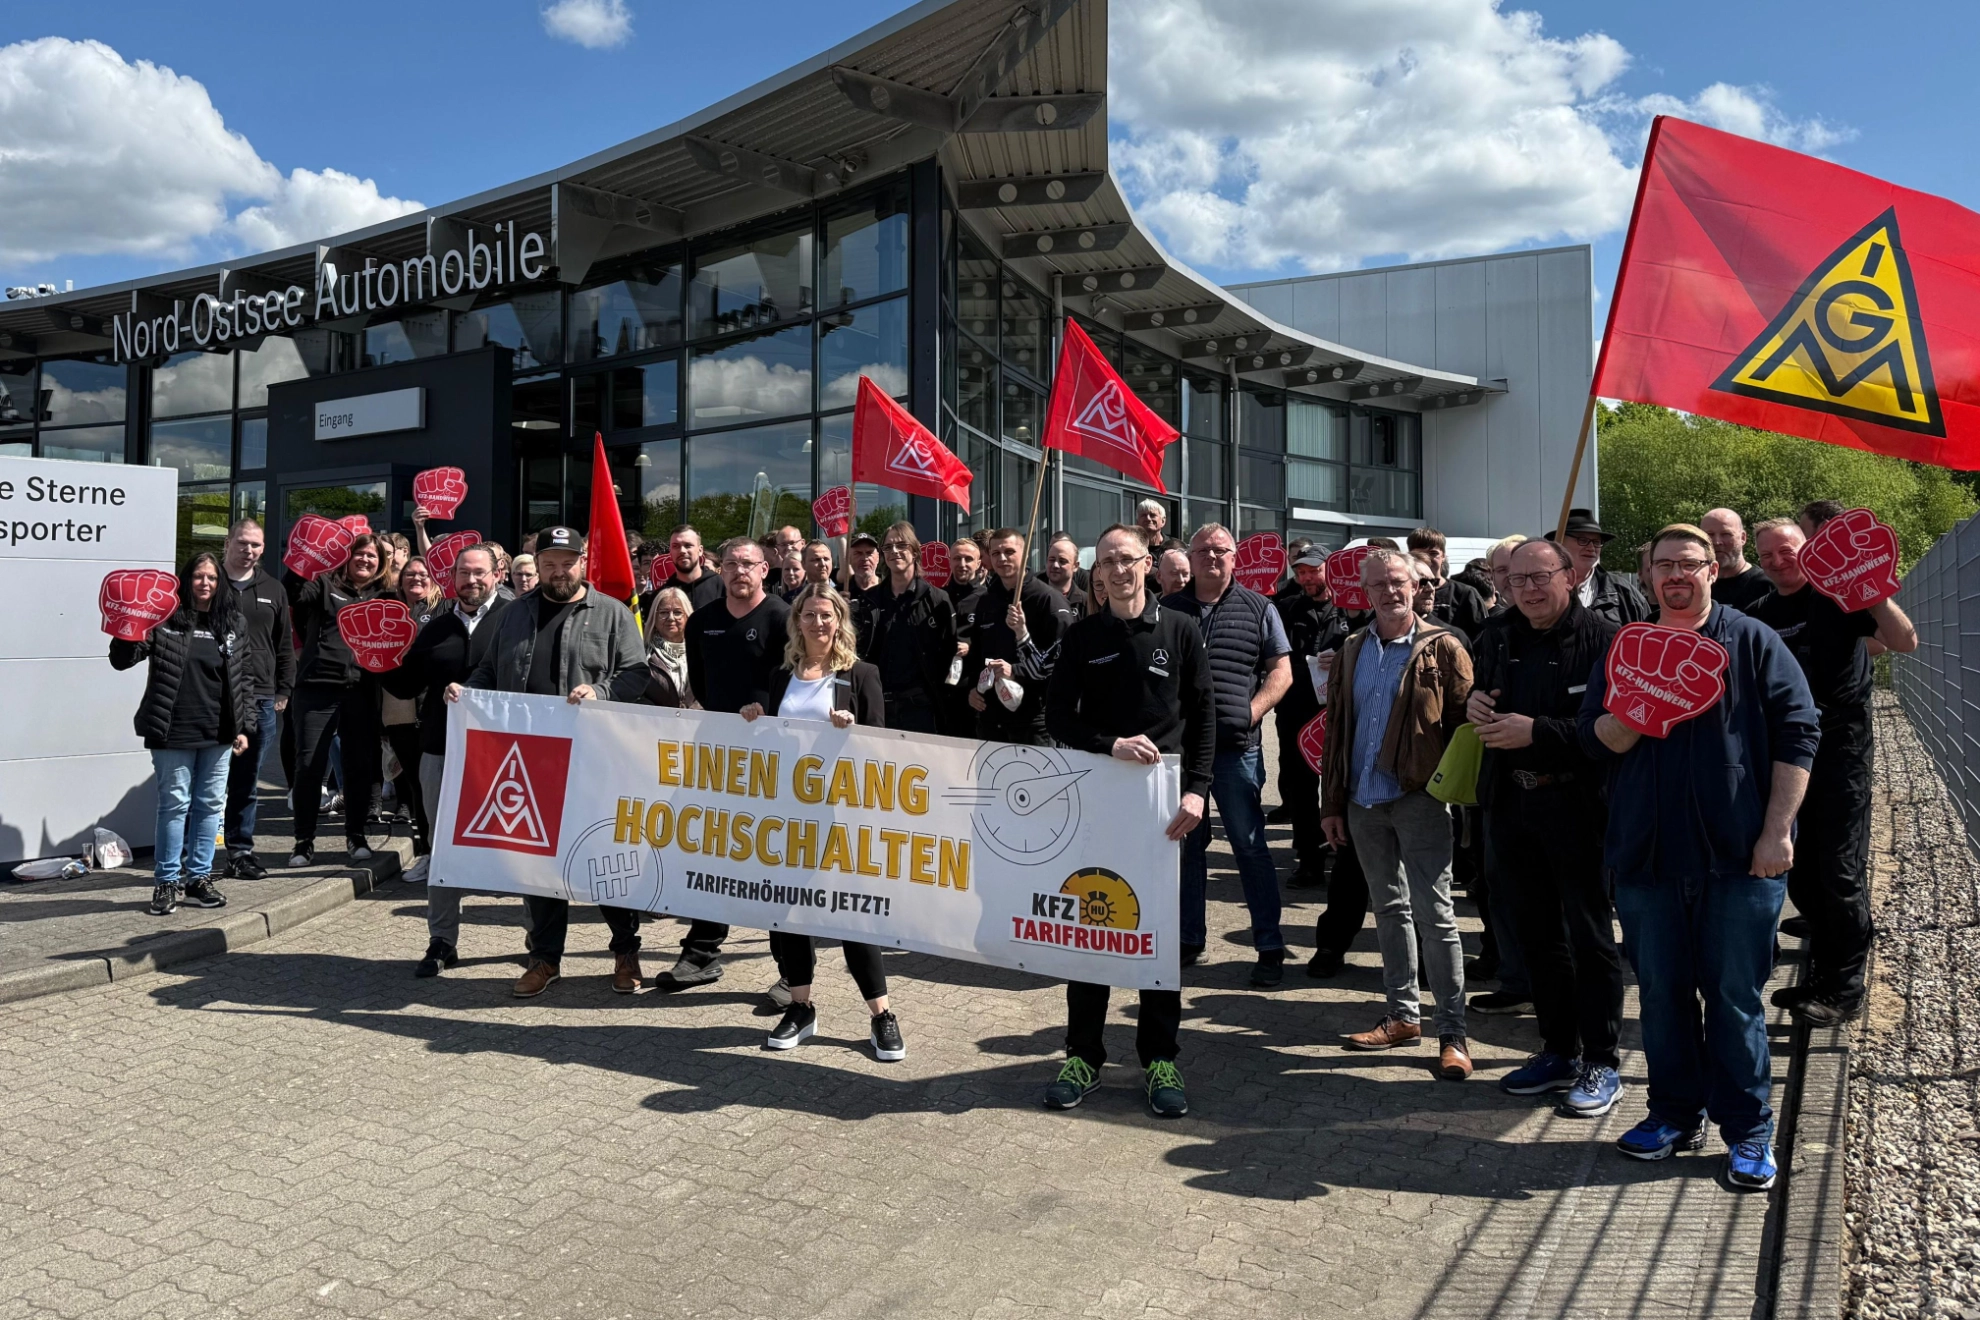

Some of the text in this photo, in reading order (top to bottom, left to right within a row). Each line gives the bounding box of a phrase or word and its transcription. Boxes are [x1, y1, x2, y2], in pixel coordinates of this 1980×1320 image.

[113, 220, 544, 362] Nord-Ostsee Automobile
[319, 413, 354, 429] Eingang
[26, 476, 126, 506] Sterne
[1822, 553, 1891, 588] KFZ-HANDWERK
[105, 600, 162, 621] KFZ-HANDWERK
[348, 637, 405, 649] KFZ-HANDWERK
[1615, 664, 1695, 710] KFZ-HANDWERK
[657, 739, 930, 816] EINEN GANG
[613, 796, 971, 891] HOCHSCHALTEN
[686, 870, 891, 917] TARIFERHÖHUNG JETZT!
[1032, 892, 1075, 921] KFZ
[1091, 904, 1105, 916] HU
[1012, 916, 1154, 955] TARIFRUNDE
